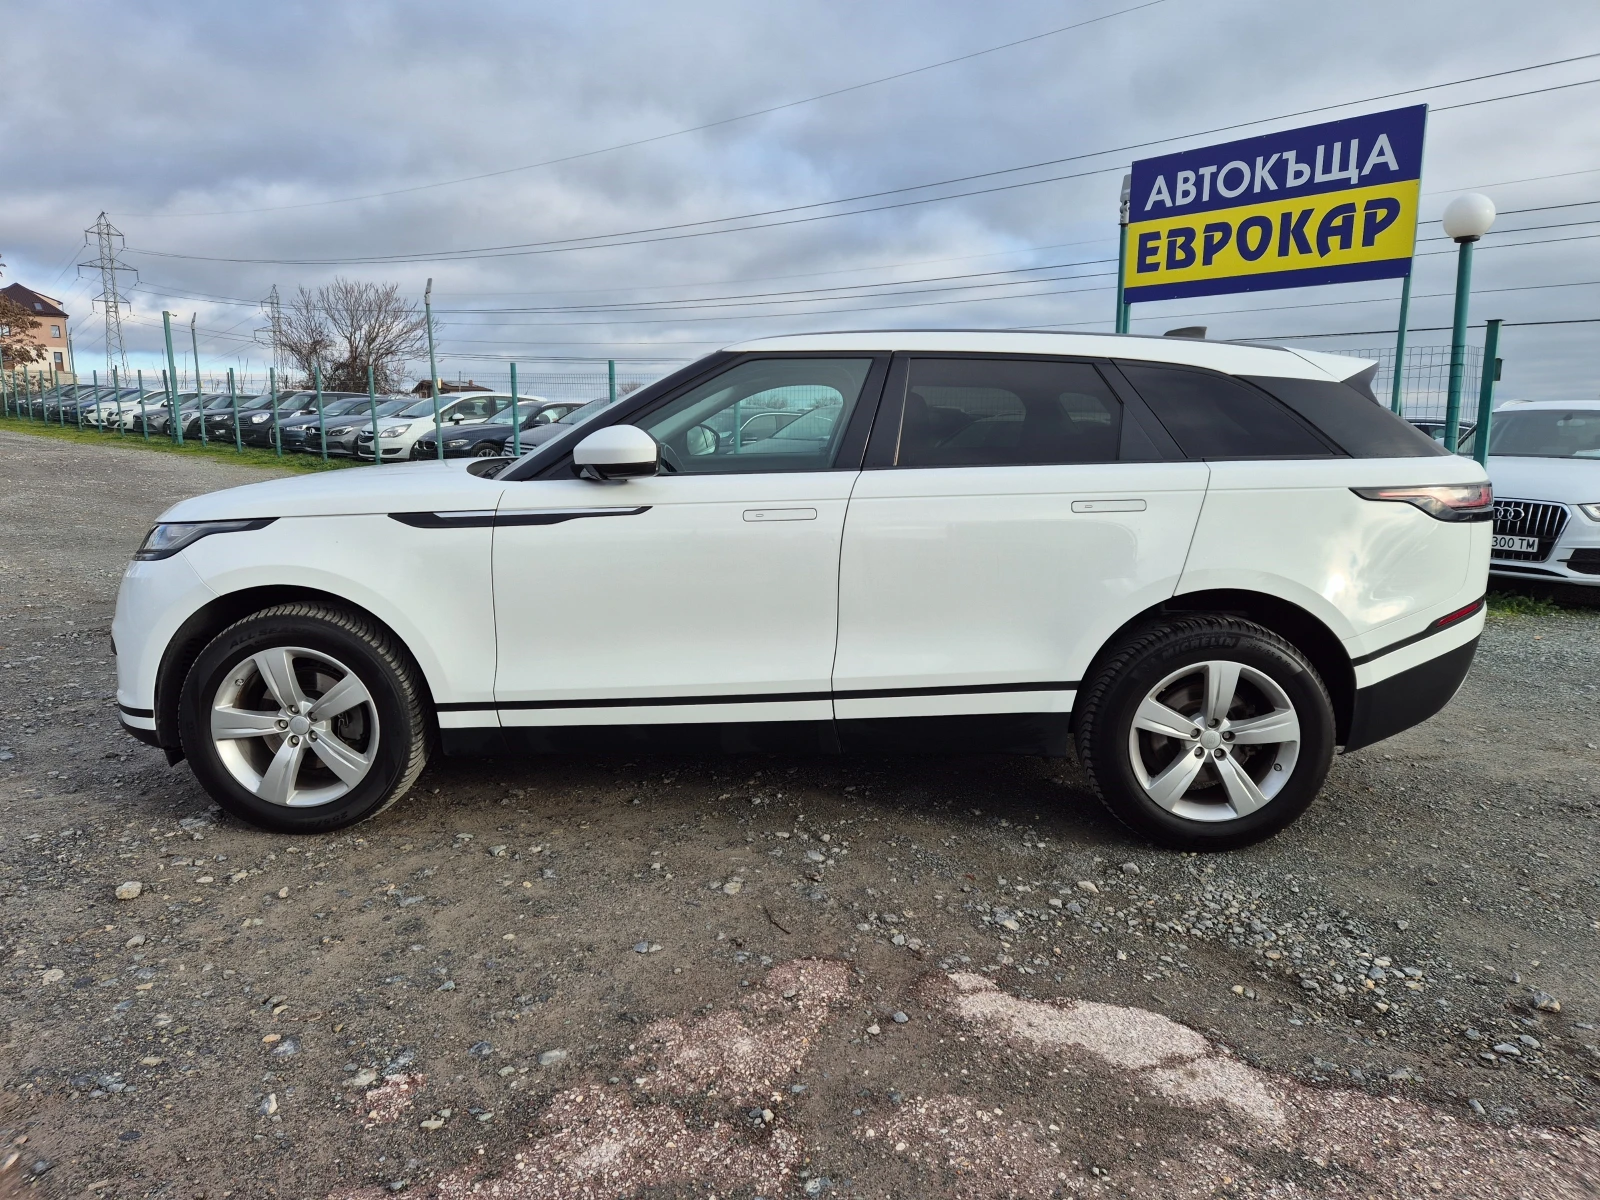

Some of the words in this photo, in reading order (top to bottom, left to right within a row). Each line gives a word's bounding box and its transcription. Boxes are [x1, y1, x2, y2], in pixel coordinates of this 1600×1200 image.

[1144, 133, 1399, 210] АВТОКЪЩА
[1136, 197, 1401, 273] ЕВРОКАР
[1518, 538, 1536, 550] TM
[229, 633, 255, 649] ALL
[1161, 636, 1237, 659] MICHELIN
